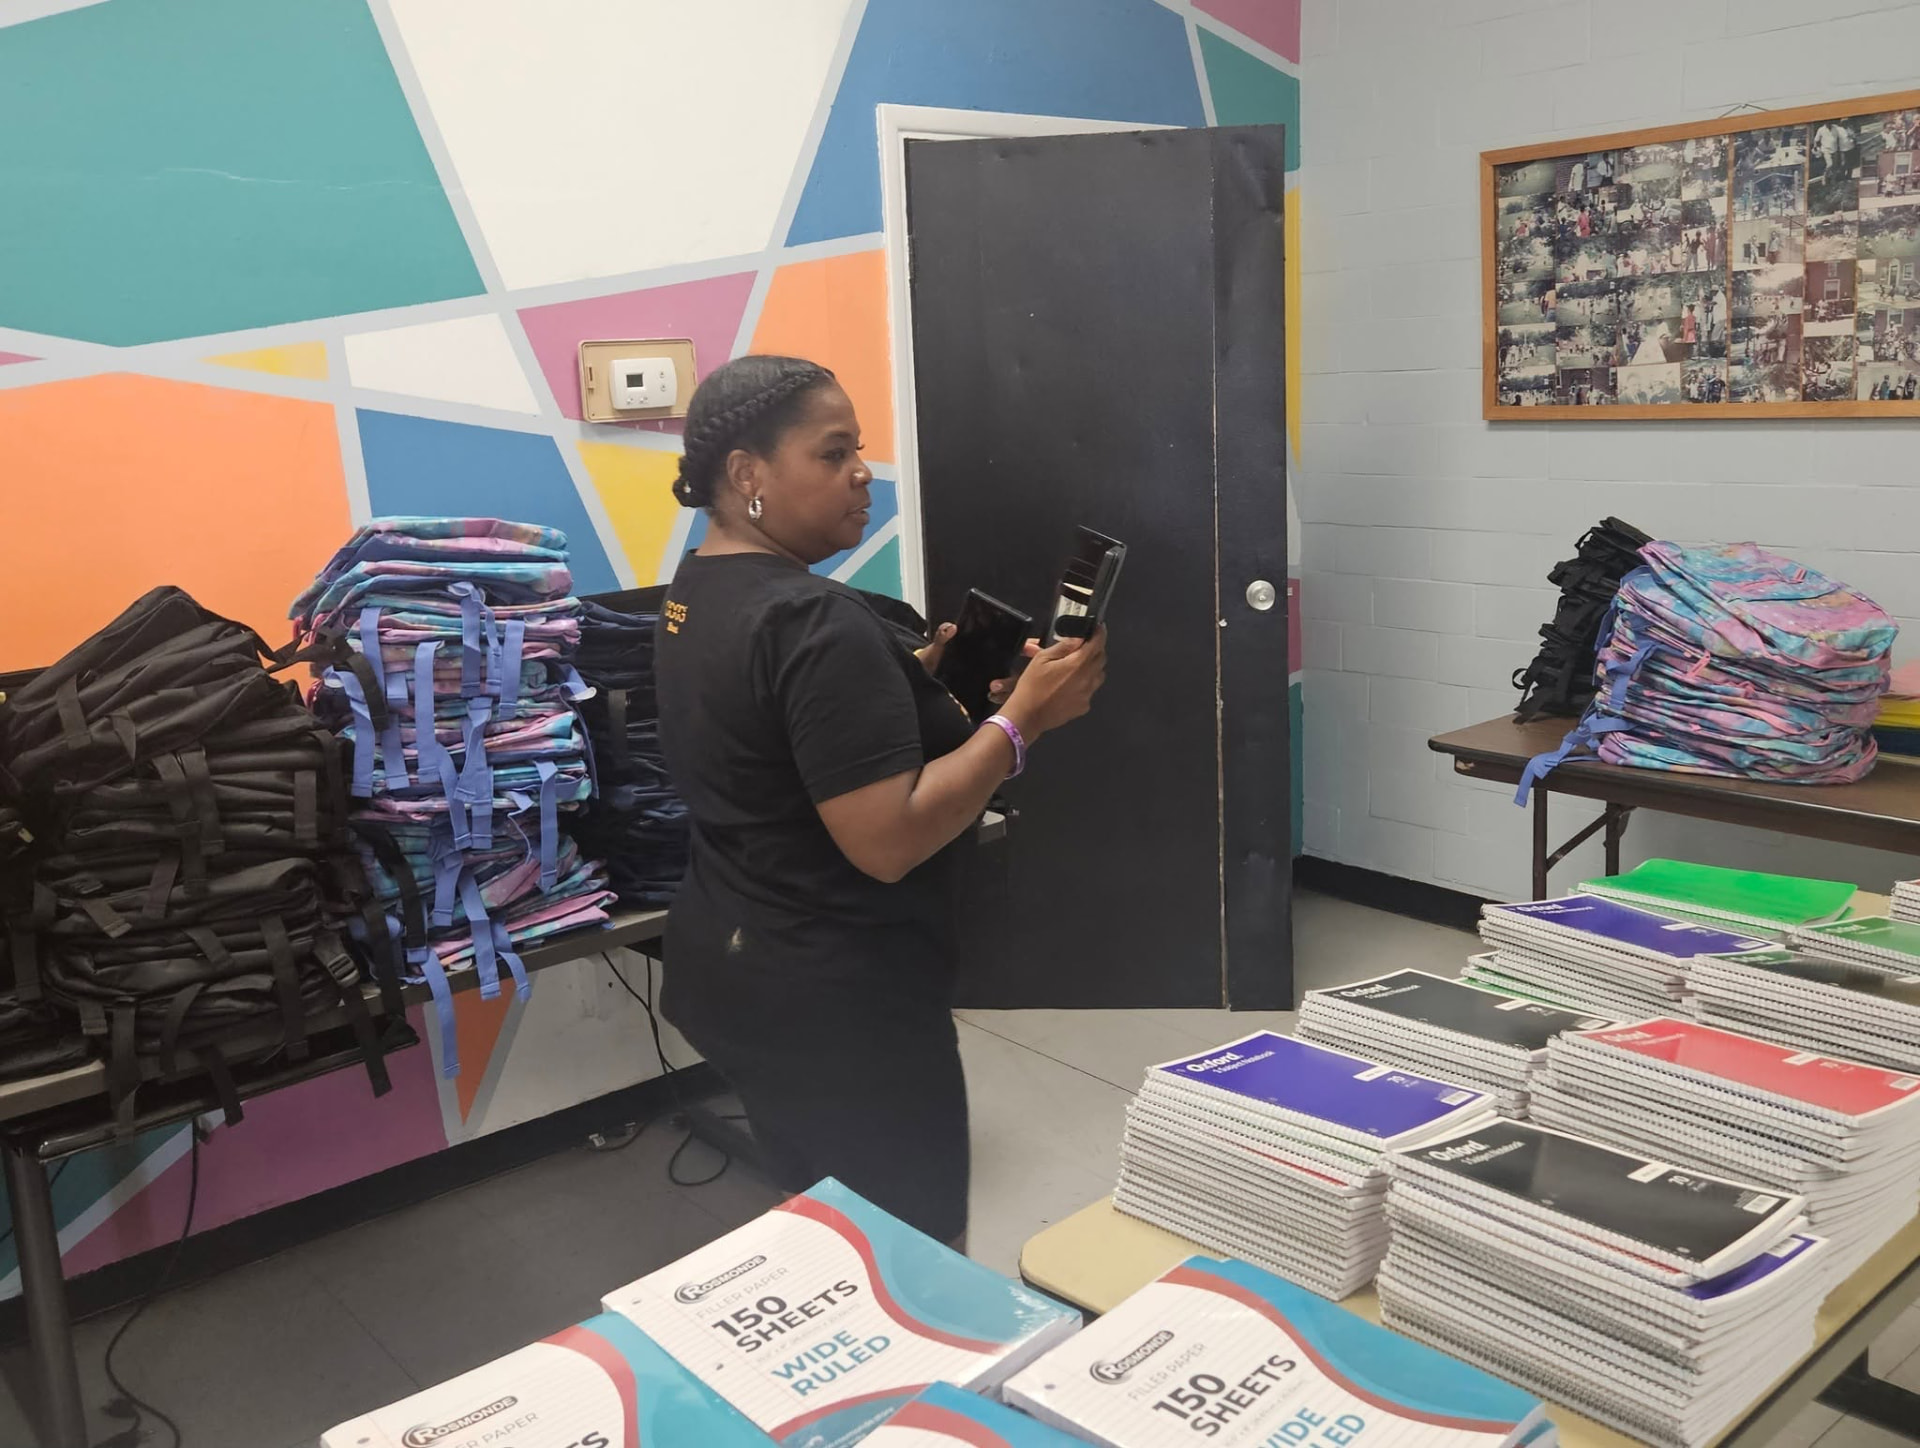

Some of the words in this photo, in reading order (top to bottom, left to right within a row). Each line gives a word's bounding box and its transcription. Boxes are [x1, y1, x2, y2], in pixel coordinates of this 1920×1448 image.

[1186, 1052, 1241, 1072] Oxford
[1428, 1140, 1485, 1161] Oxford
[697, 1291, 743, 1318] FILLER
[743, 1267, 789, 1295] PAPER
[712, 1296, 787, 1337] 150
[736, 1280, 858, 1353] SHEETS
[771, 1330, 859, 1380] WIDE
[790, 1335, 891, 1397] RULED
[1127, 1369, 1168, 1401] FILLER
[1168, 1341, 1208, 1374] PAPER
[1152, 1373, 1226, 1420] 150
[1190, 1354, 1297, 1437] SHEETS
[481, 1411, 539, 1444] PAPER
